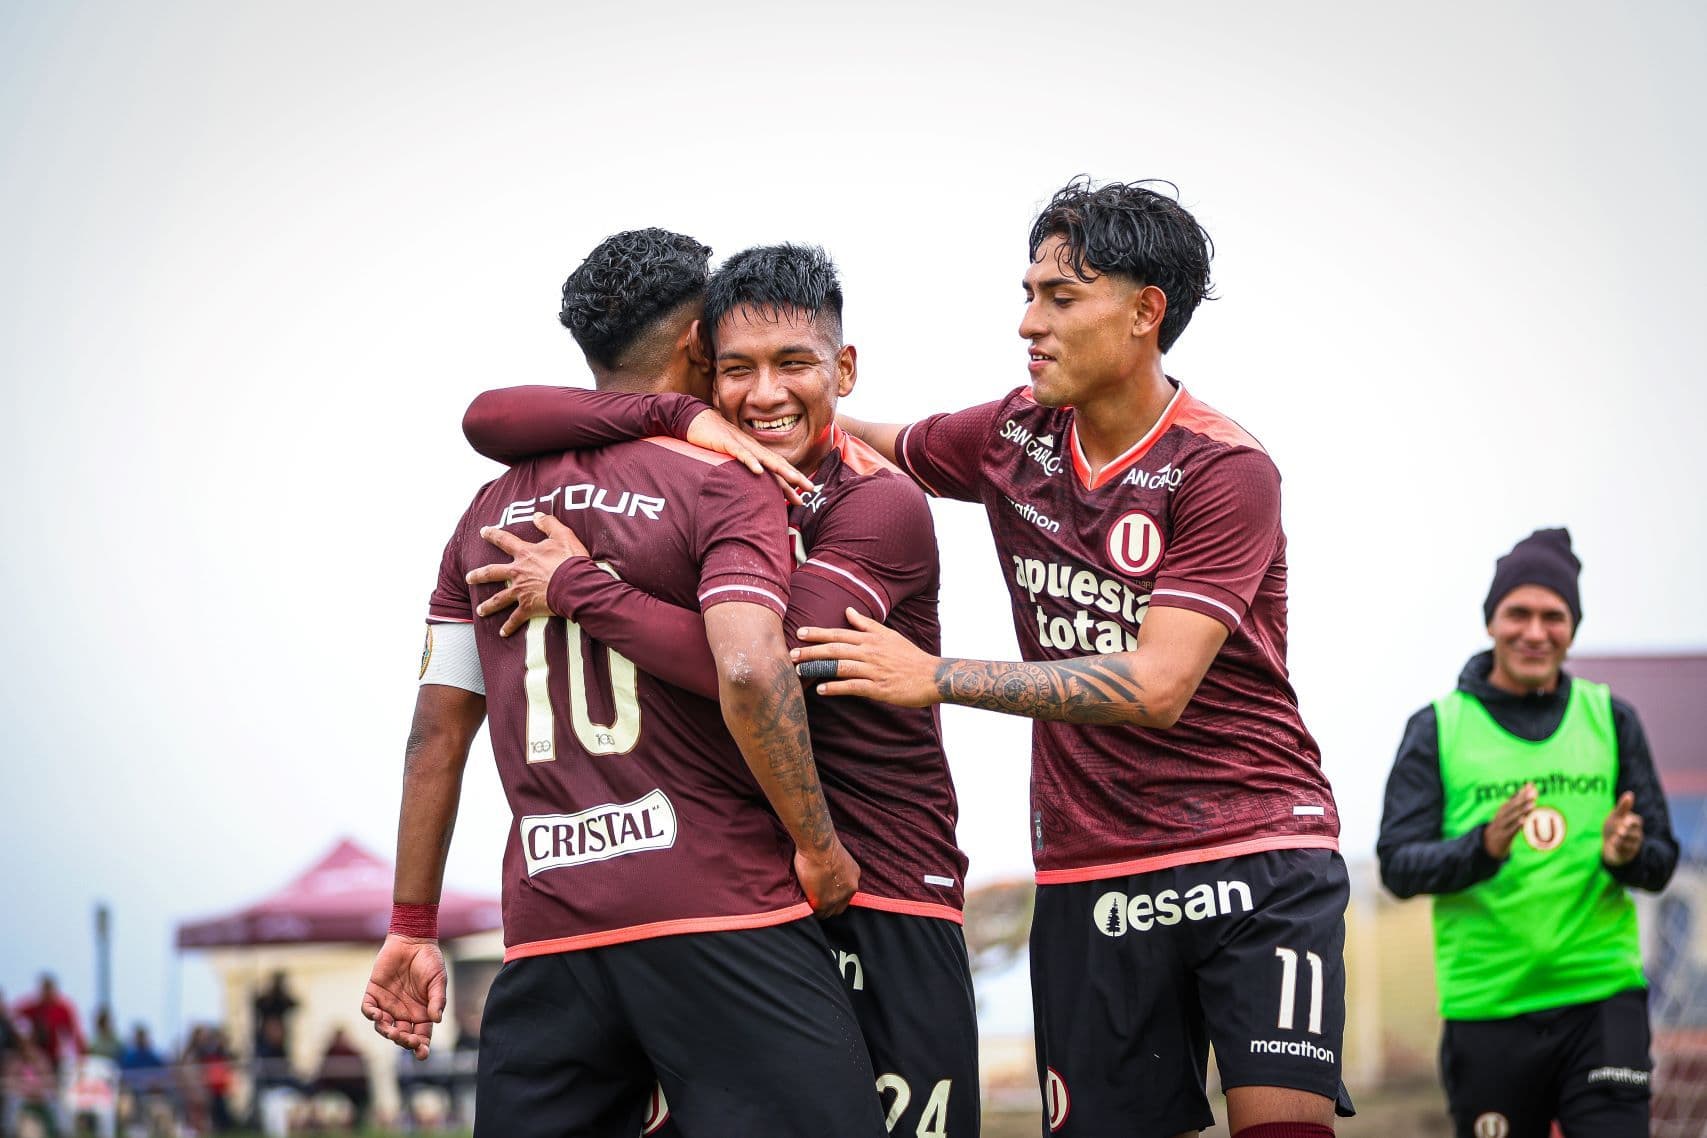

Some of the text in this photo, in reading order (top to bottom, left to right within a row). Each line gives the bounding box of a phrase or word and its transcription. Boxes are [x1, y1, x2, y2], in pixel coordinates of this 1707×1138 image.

[1000, 419, 1033, 446] SAN
[1122, 468, 1150, 487] AN
[483, 483, 666, 529] JETOUR
[1121, 521, 1151, 568] U
[506, 561, 641, 764] 10
[1475, 770, 1608, 804] maathon
[527, 811, 665, 861] CRISTAL
[1533, 816, 1555, 845] U
[1127, 880, 1254, 932] esan
[1275, 946, 1325, 1036] 11
[1250, 1039, 1335, 1065] marathon
[875, 1073, 953, 1138] 24
